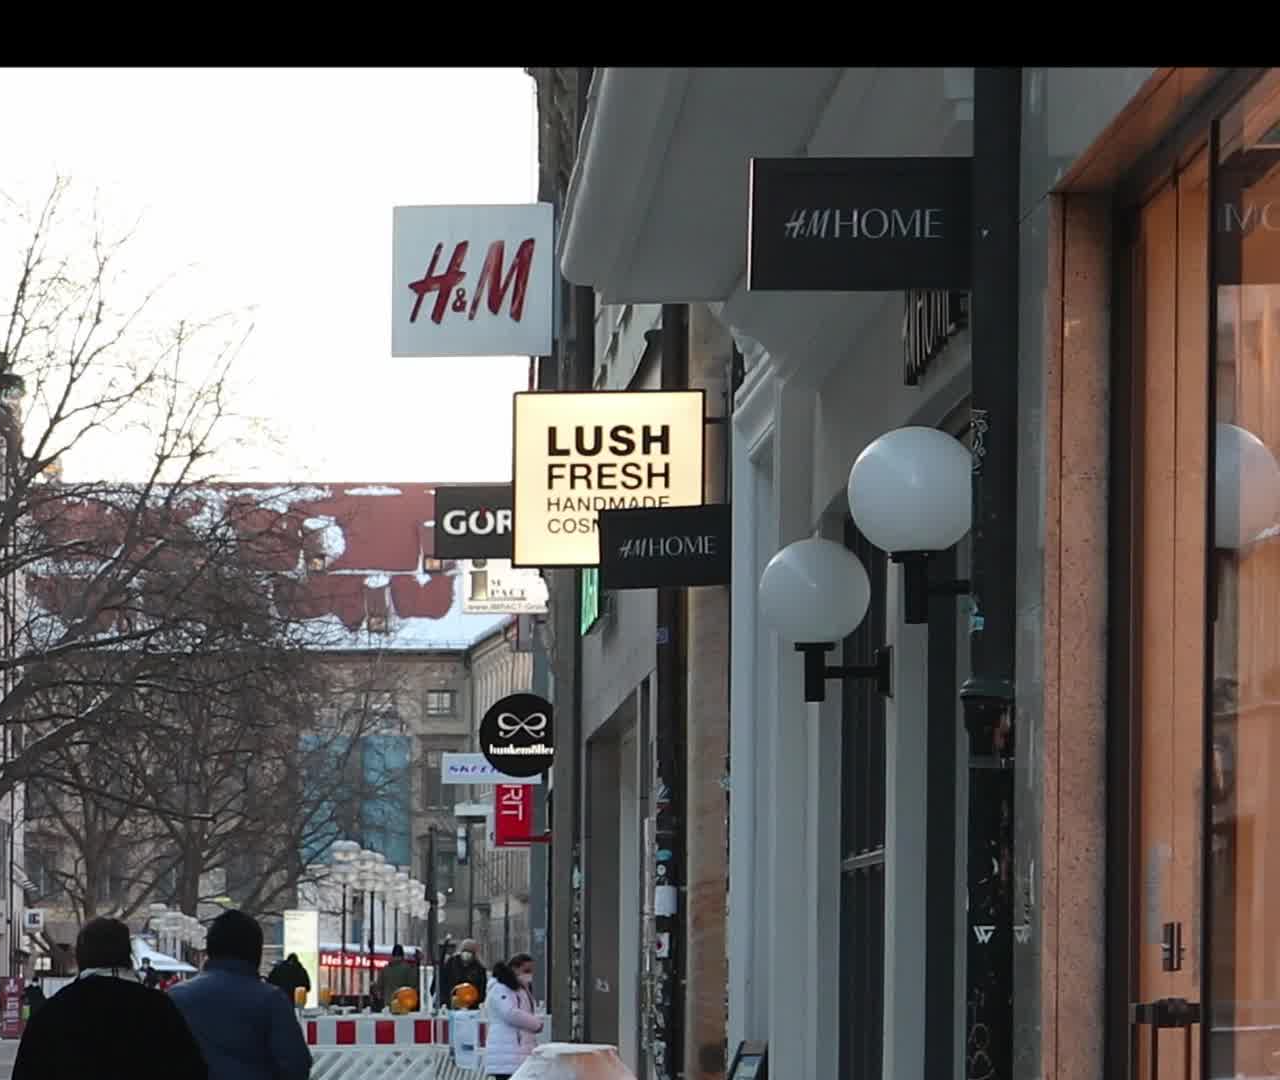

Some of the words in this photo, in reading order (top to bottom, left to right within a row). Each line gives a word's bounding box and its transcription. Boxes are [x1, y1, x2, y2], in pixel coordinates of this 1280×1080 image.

[833, 208, 944, 239] HOME
[408, 237, 536, 325] H&M
[547, 424, 670, 457] LUSH
[547, 462, 670, 490] FRESH
[547, 496, 670, 512] HANDMADE
[648, 535, 716, 558] HOME
[489, 743, 554, 755] hunkemöller
